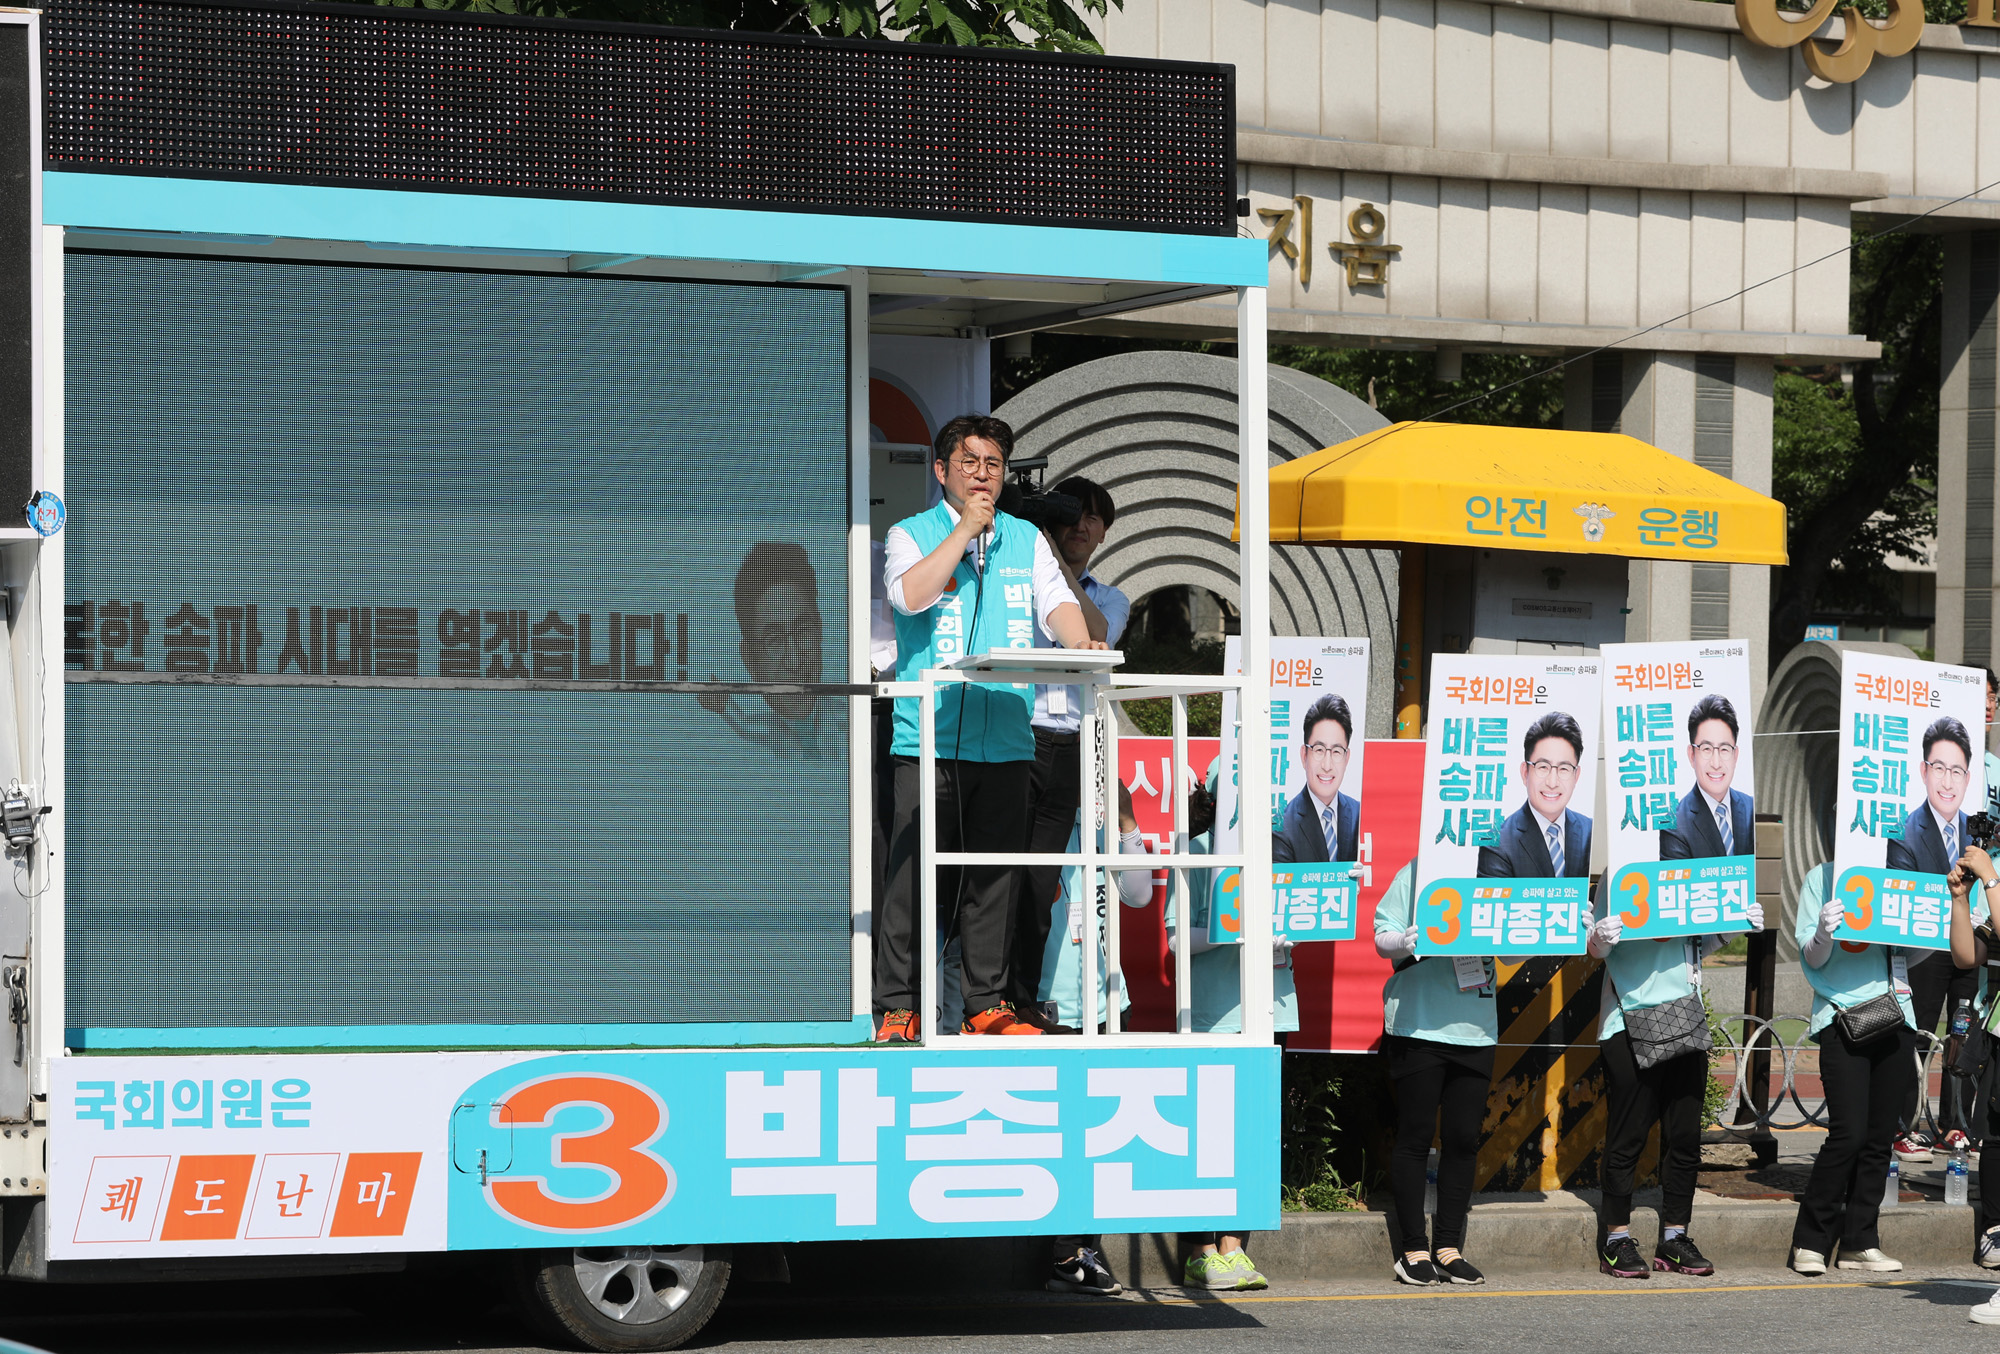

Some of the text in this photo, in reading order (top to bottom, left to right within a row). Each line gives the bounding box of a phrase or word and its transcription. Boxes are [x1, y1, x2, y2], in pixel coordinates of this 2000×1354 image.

[1465, 495, 1719, 549] 안전 운행
[163, 603, 264, 673] 송파
[277, 605, 420, 676] 시대를
[437, 608, 688, 681] 열겠습니다!
[1577, 665, 1597, 674] 송파을
[1614, 661, 1704, 692] 국회의원은
[1445, 676, 1548, 705] 국회의원은
[1854, 673, 1941, 708] 국회의원은
[1442, 717, 1508, 757] 바른
[1616, 703, 1674, 743] 바른
[1853, 712, 1909, 754] 바른
[1439, 762, 1507, 802] 송파
[1618, 747, 1677, 788] 송파
[1852, 755, 1910, 798] 송파
[1435, 808, 1506, 848] 사람
[1621, 791, 1679, 831] 사람
[1850, 799, 1909, 841] 사람
[1522, 887, 1545, 899] 송파에
[1546, 887, 1562, 898] 살고
[1563, 887, 1579, 898] 있는
[1620, 872, 1748, 929] 3 박종진
[1843, 874, 1874, 931] 3
[1426, 887, 1579, 945] 3 박종진
[73, 1078, 312, 1131] 국회의원은
[484, 1064, 1238, 1235] 3 박종진
